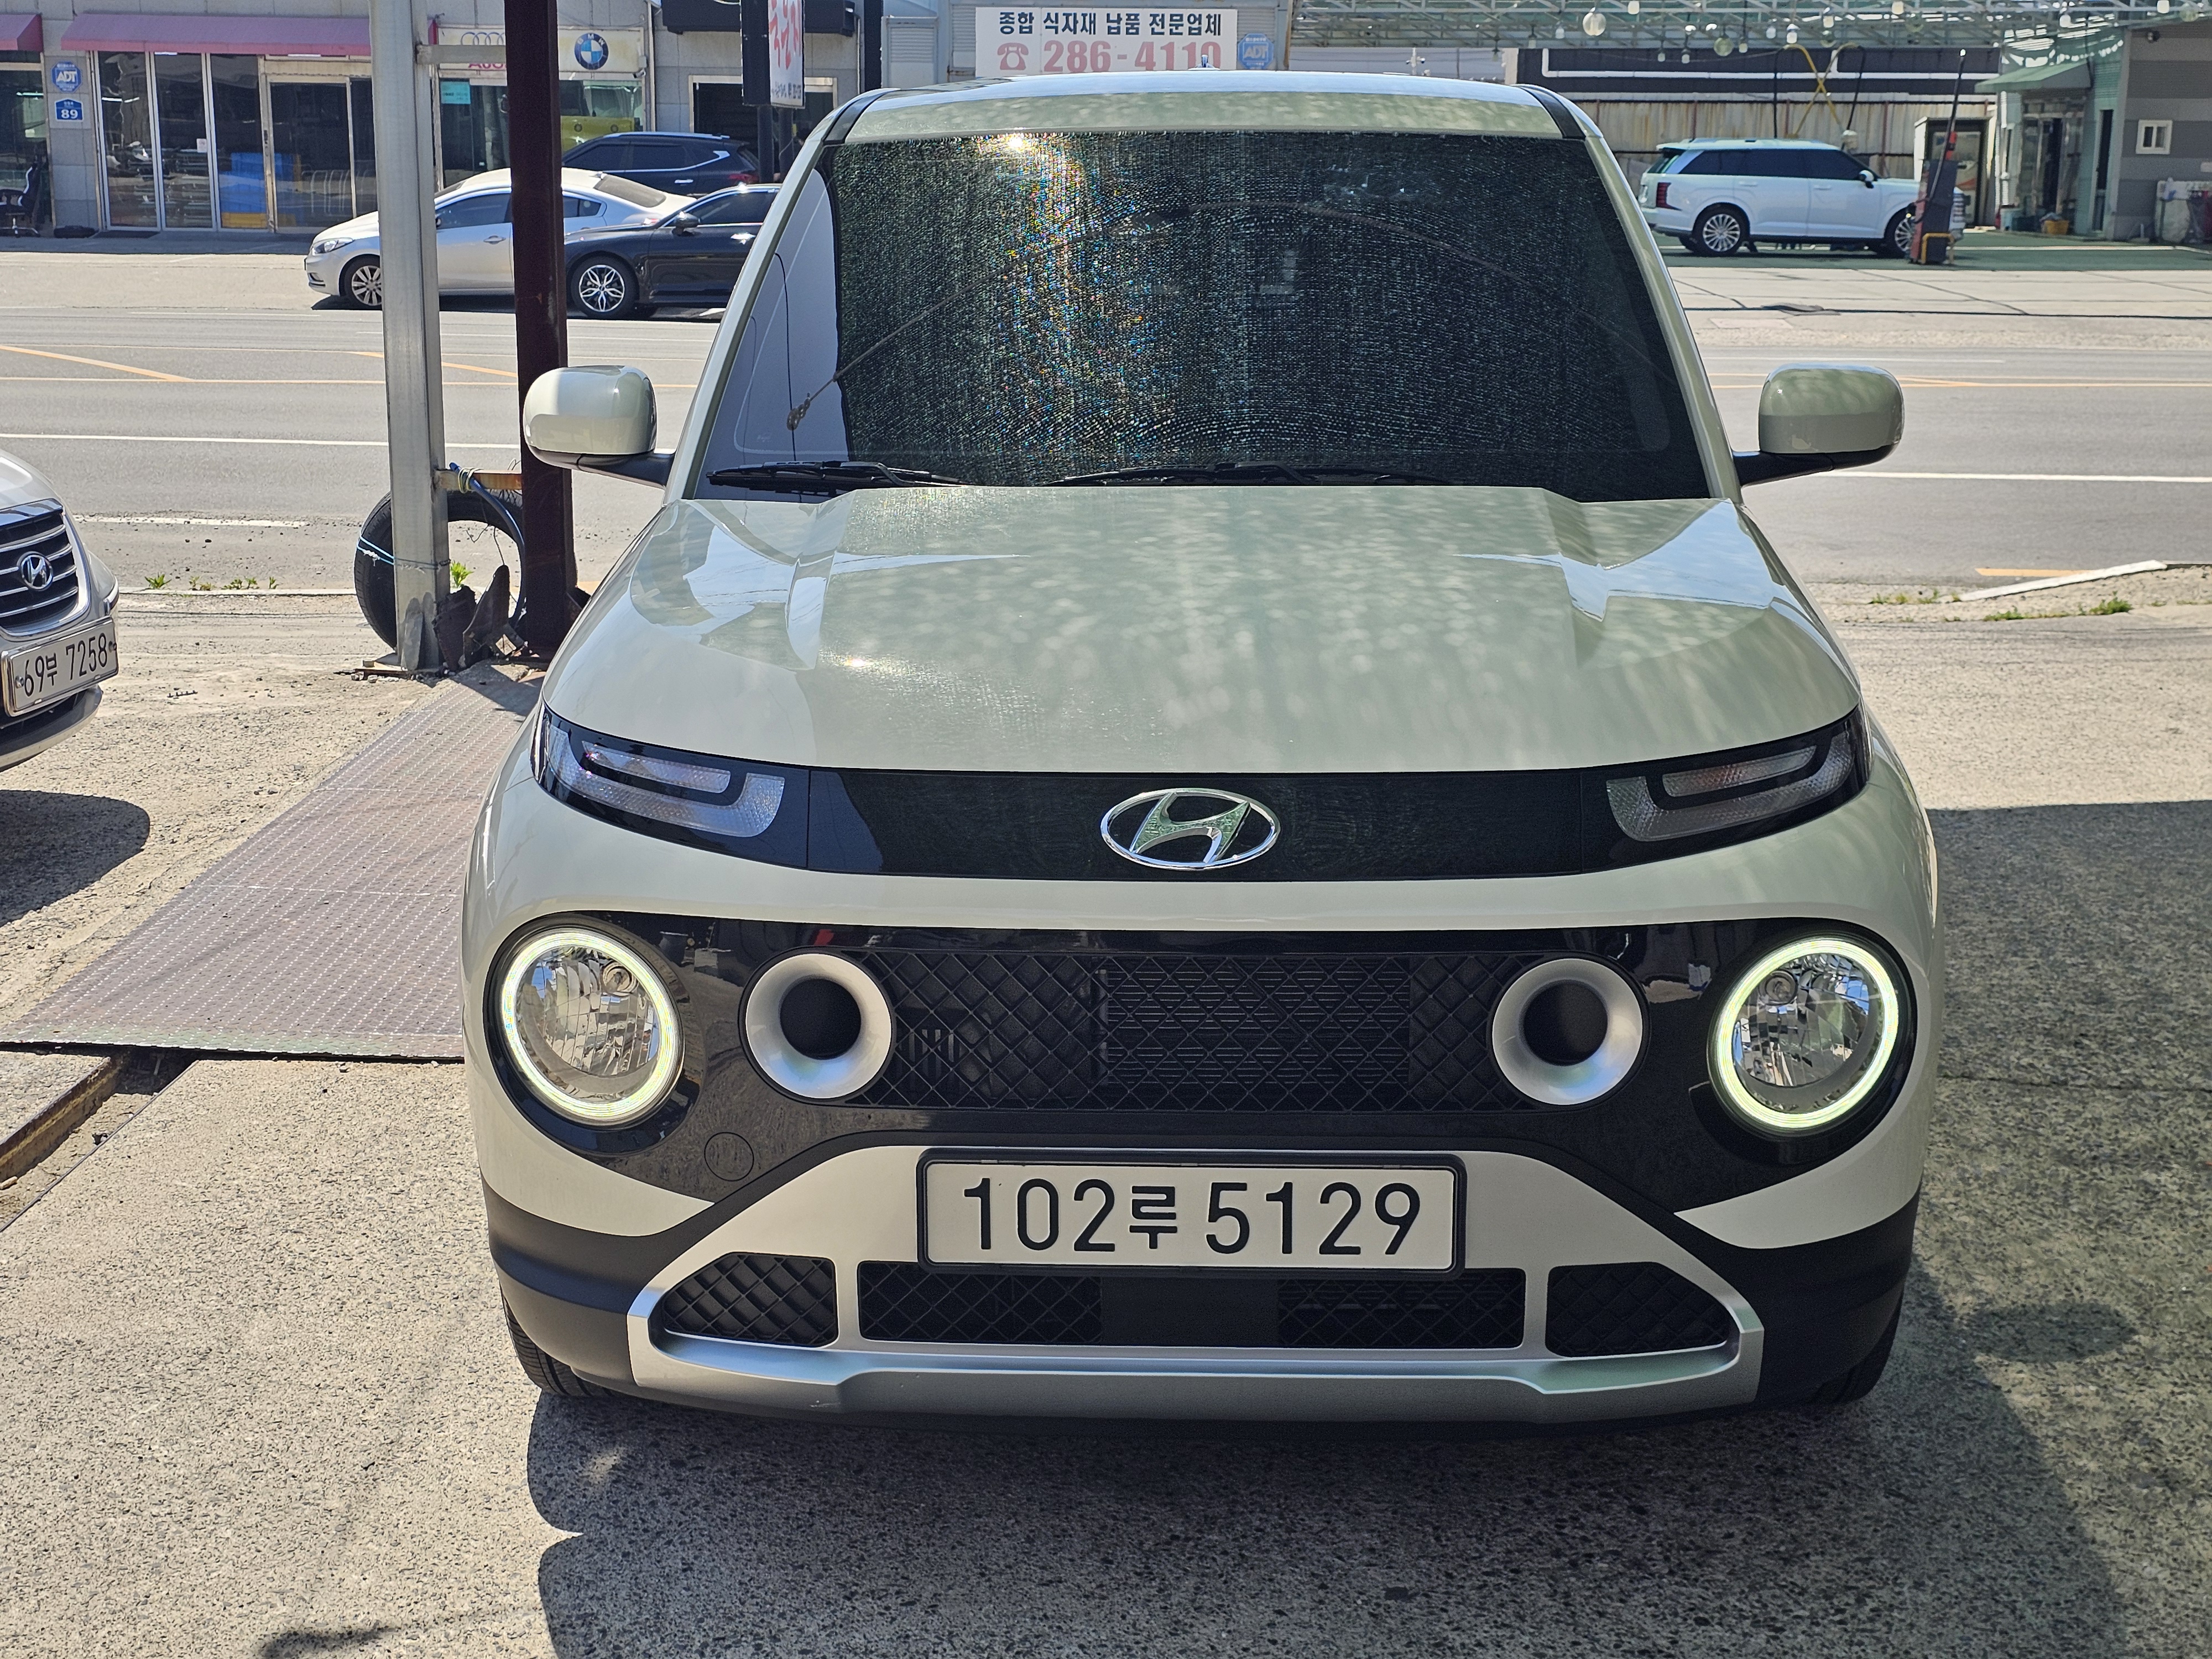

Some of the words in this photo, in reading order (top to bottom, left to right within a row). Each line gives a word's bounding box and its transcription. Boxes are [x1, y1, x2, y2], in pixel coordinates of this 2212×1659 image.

[1000, 12, 1034, 35] 종합
[1043, 12, 1096, 35] 식자재
[1107, 13, 1140, 35] 납품
[1149, 13, 1221, 36] 전문업체
[1044, 40, 1222, 72] 286-4110
[1244, 45, 1269, 59] ADT
[56, 70, 77, 82] ADT
[61, 109, 78, 119] 89
[24, 653, 58, 697] 69부
[66, 632, 108, 681] 7258
[963, 1177, 1178, 1253] 102루
[1205, 1181, 1421, 1255] 5129
